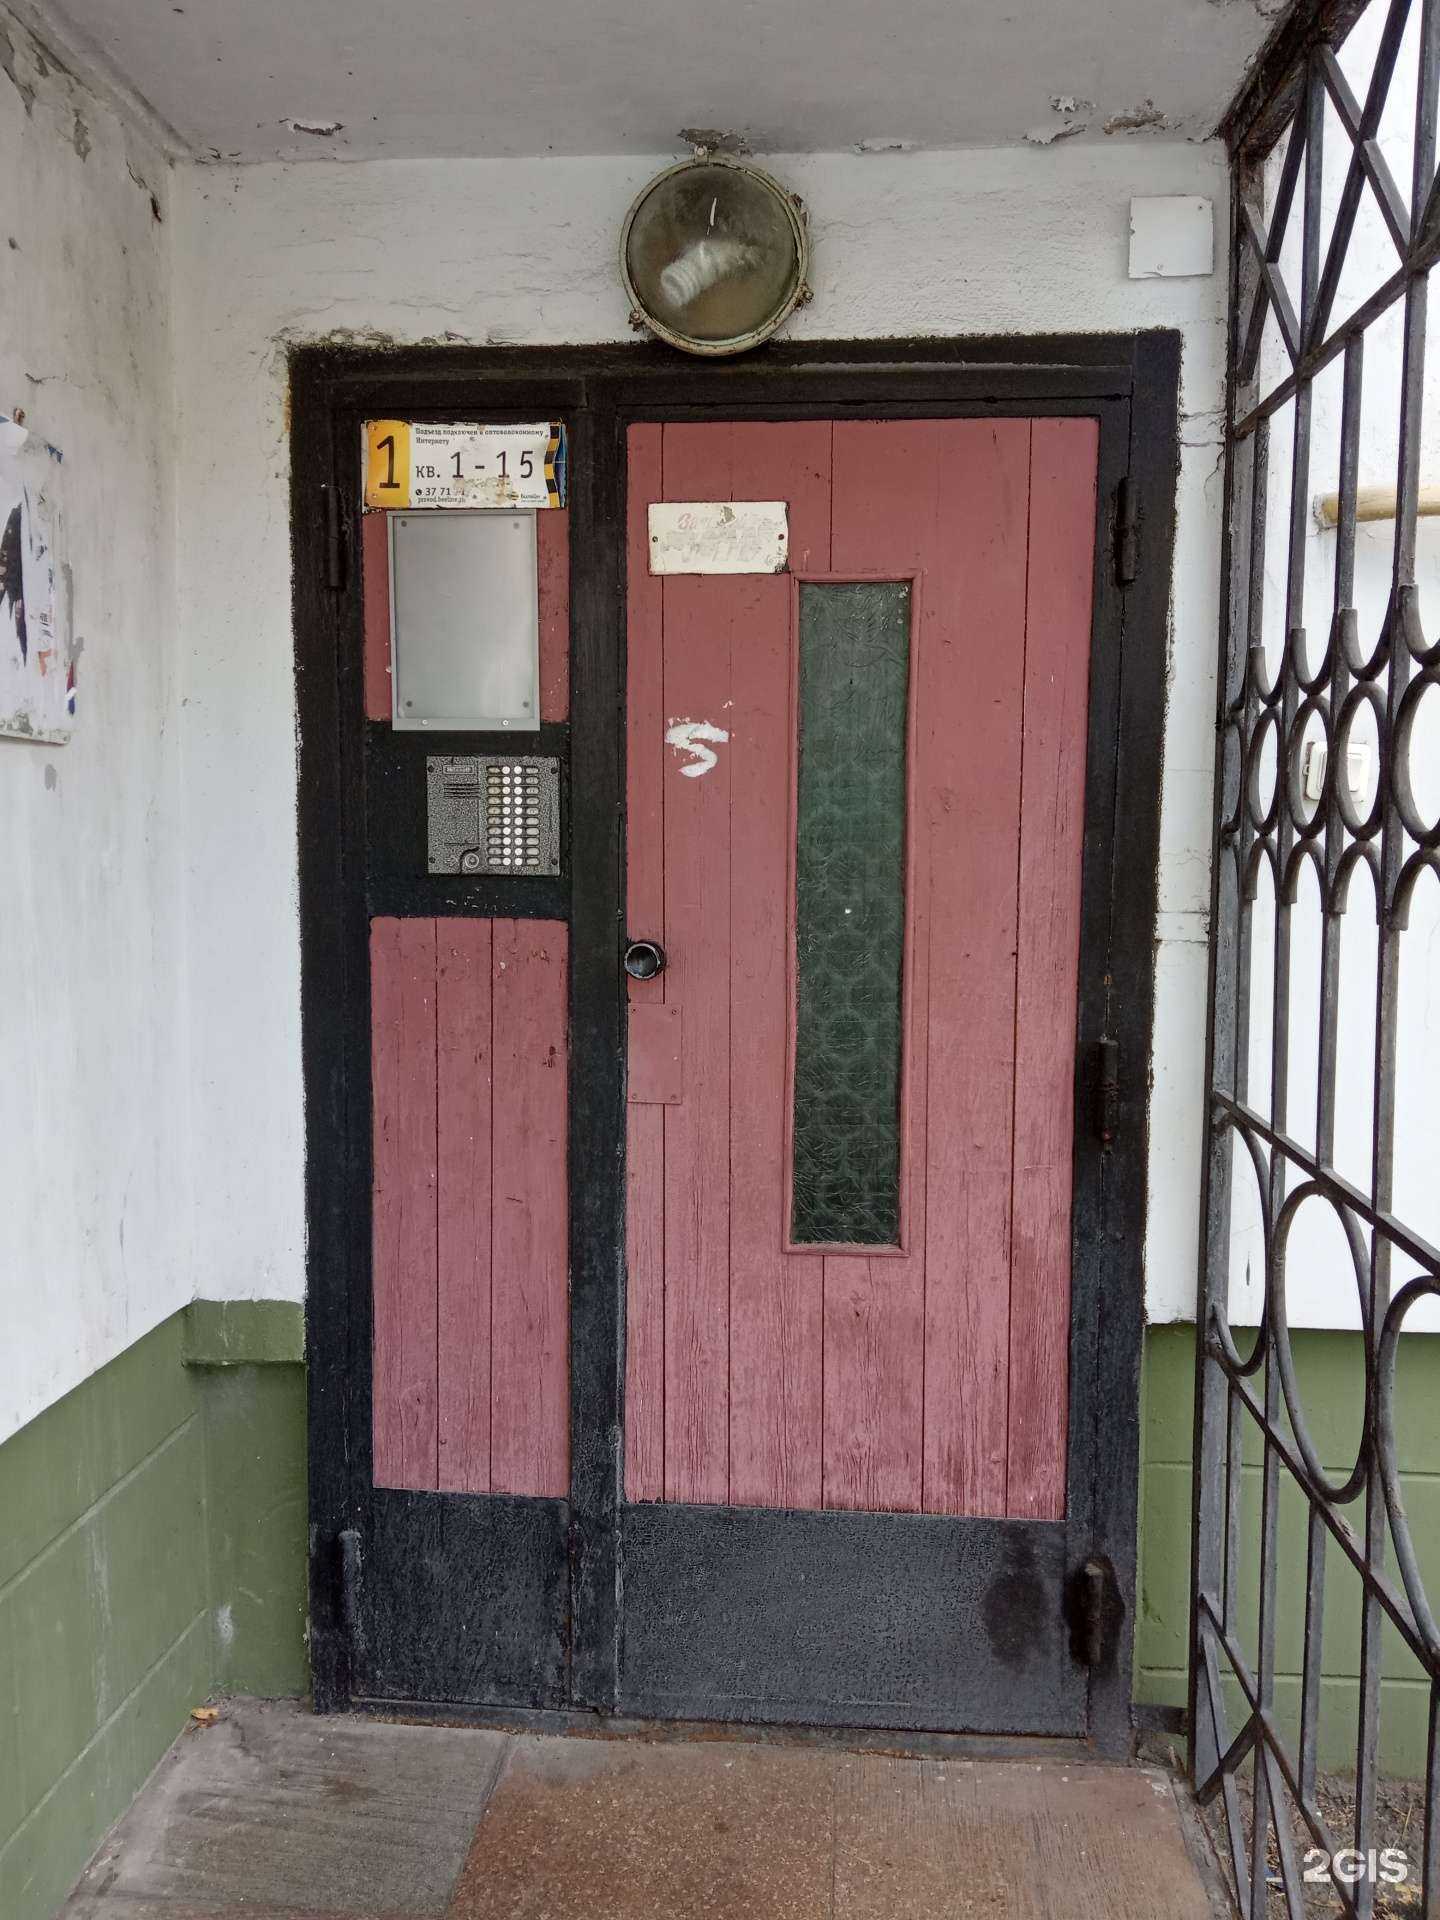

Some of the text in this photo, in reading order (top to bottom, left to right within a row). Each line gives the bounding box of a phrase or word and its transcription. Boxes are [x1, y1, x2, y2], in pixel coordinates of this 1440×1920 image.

[376, 435, 401, 489] 1
[425, 487, 437, 496] 37
[440, 487, 451, 496] 71
